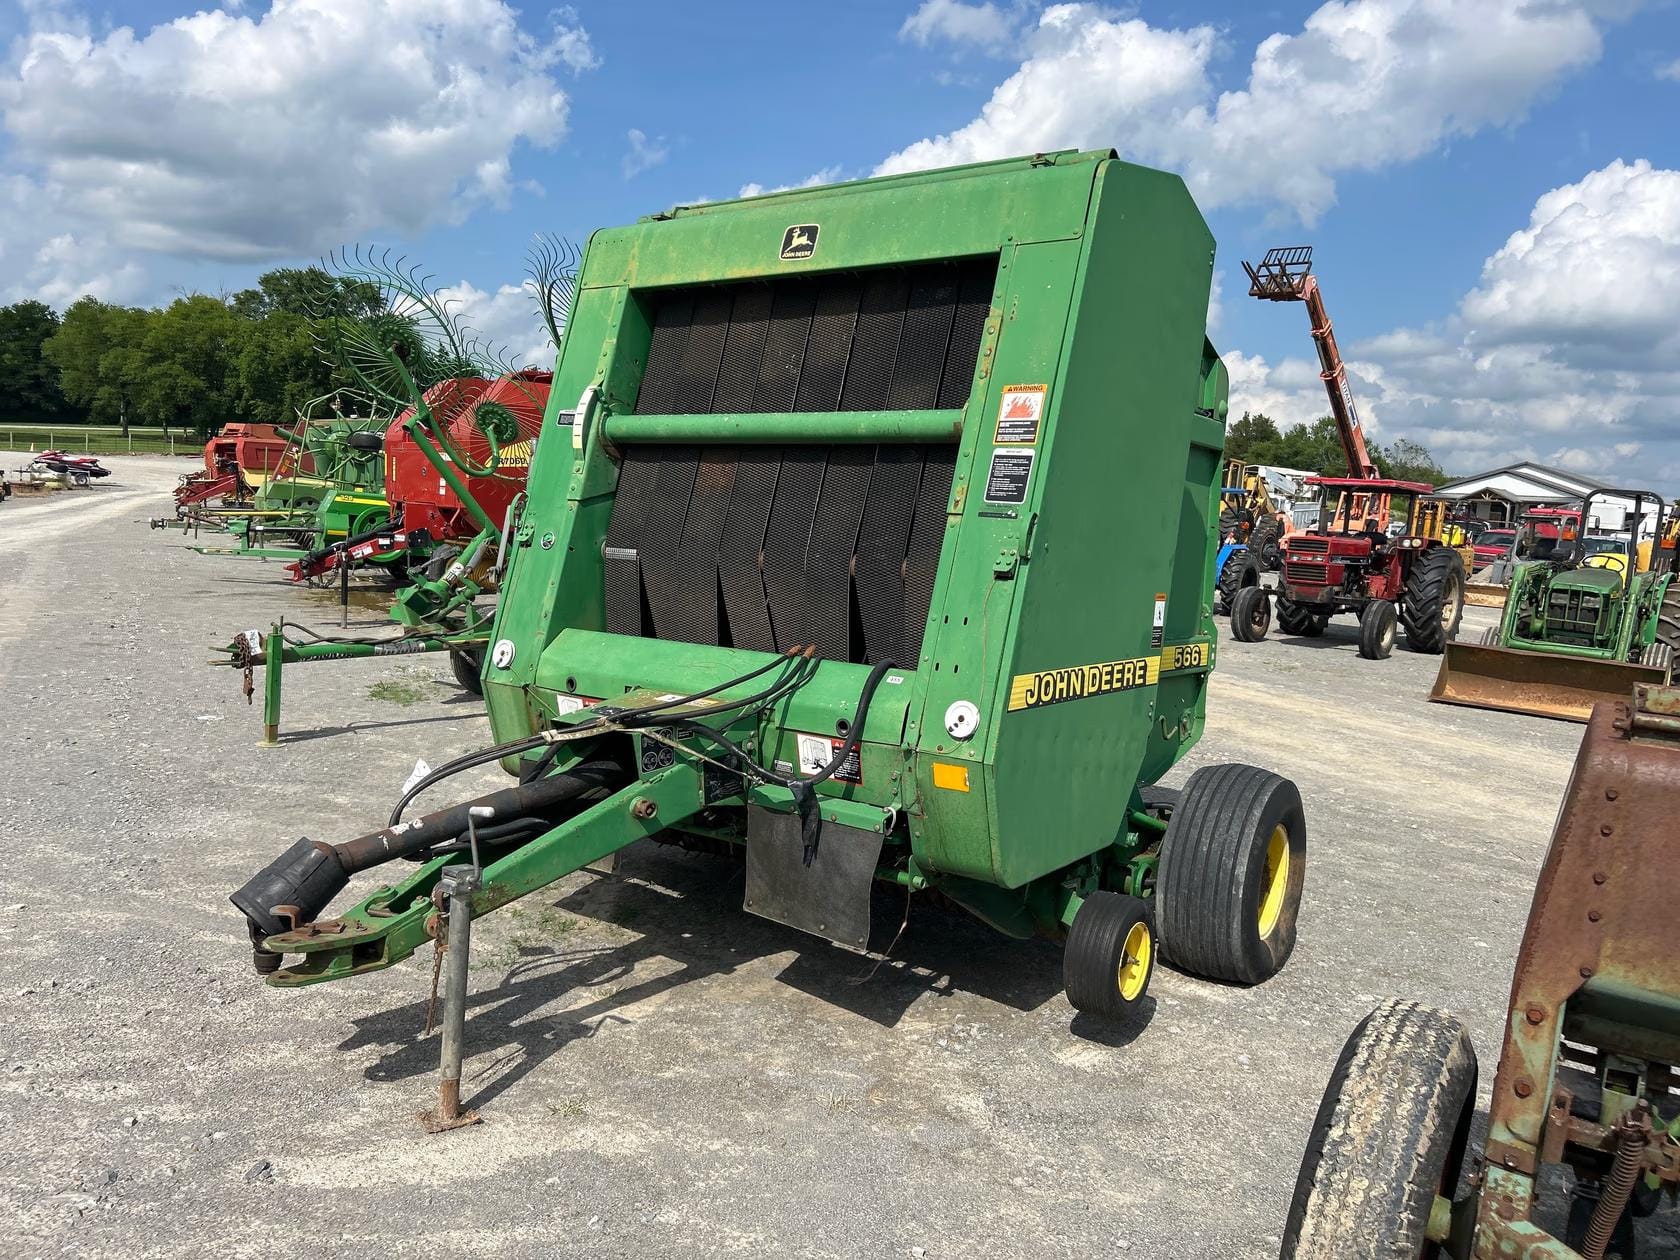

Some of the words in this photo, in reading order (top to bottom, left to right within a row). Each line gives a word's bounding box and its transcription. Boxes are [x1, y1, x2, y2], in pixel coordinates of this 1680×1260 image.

[498, 457, 527, 465] R7060
[1174, 646, 1200, 668] 566
[1026, 668, 1085, 706] JOHN
[1087, 659, 1147, 694] DEERE
